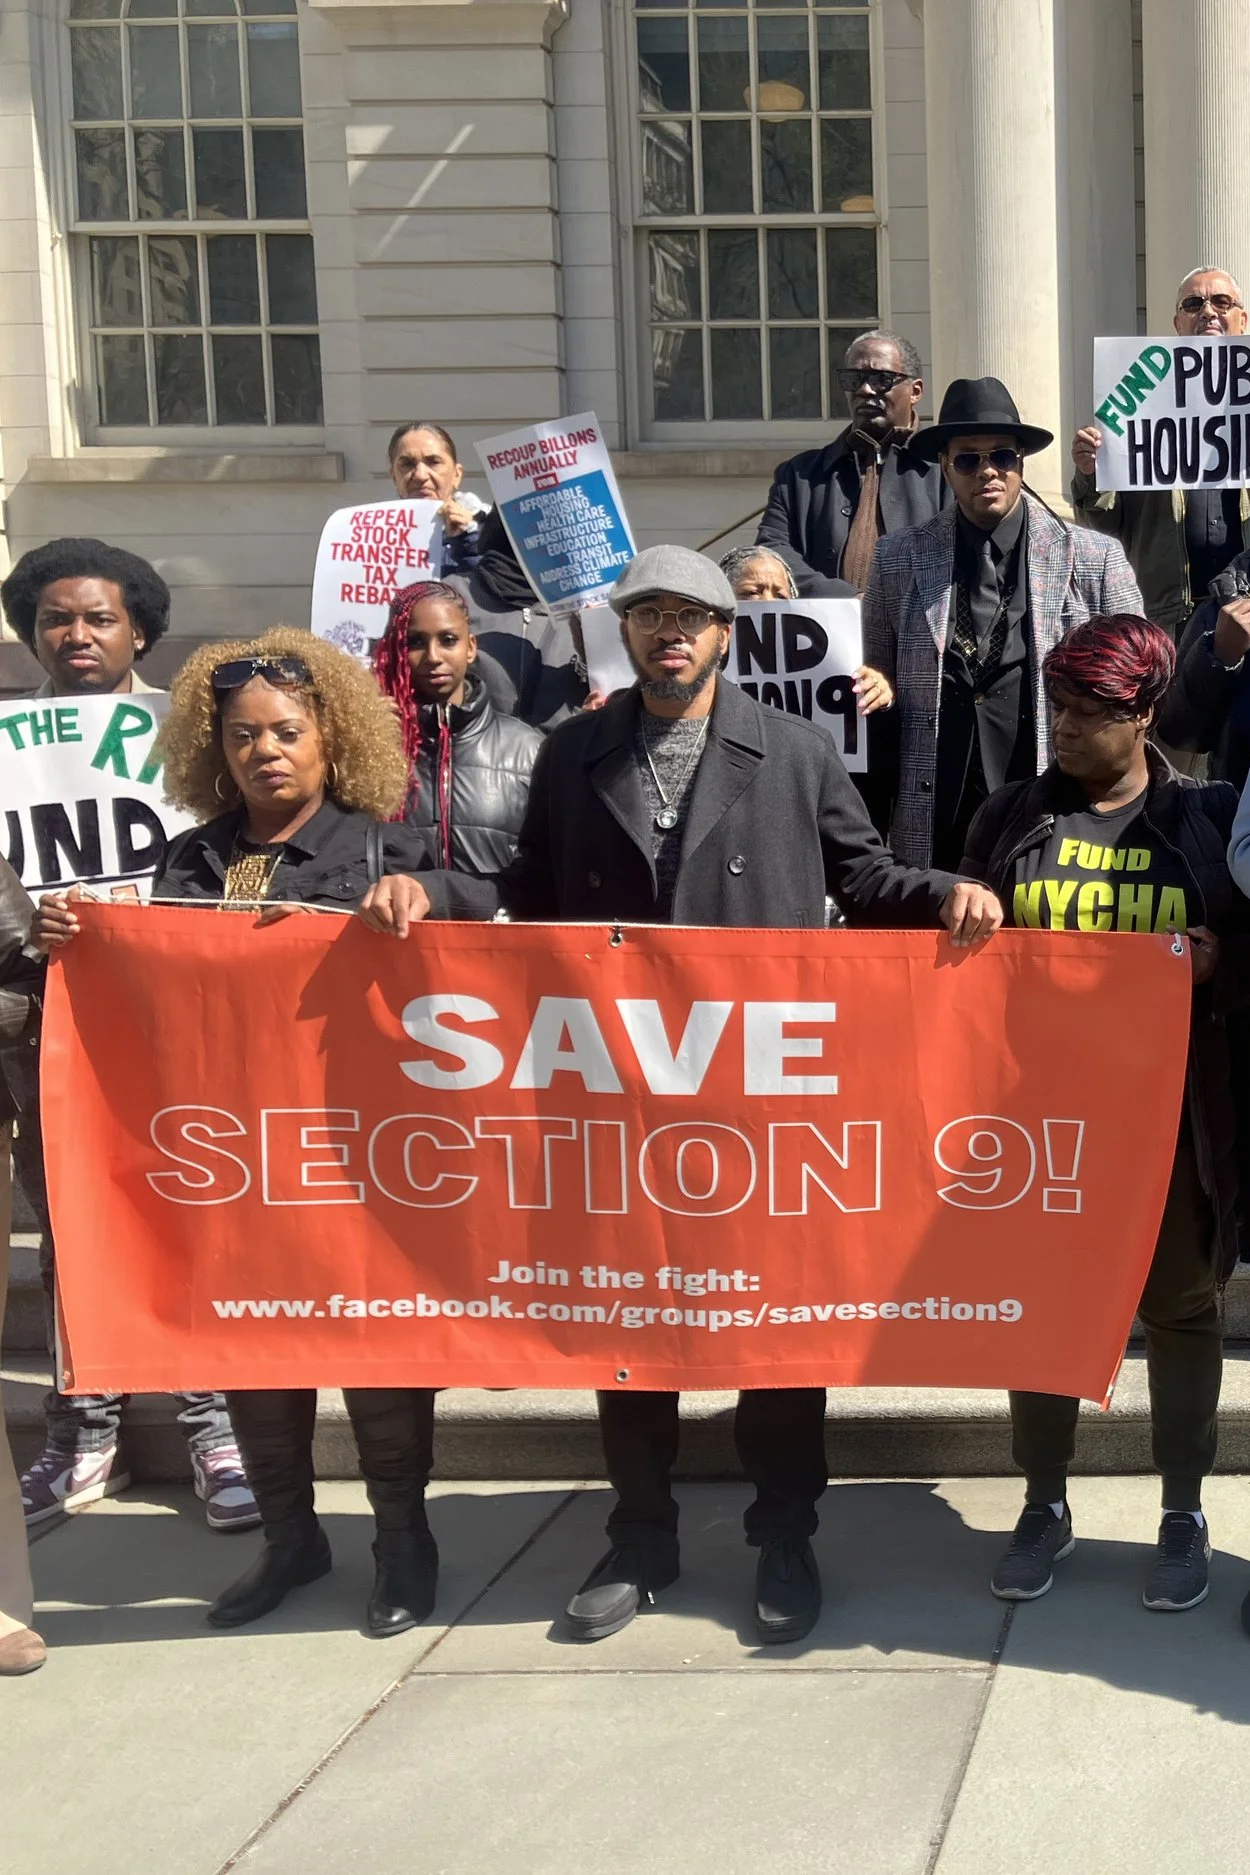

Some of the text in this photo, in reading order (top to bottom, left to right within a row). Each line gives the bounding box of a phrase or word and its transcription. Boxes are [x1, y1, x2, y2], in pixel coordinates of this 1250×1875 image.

[1094, 345, 1172, 437] FUND
[487, 443, 537, 470] RECOUP
[513, 450, 578, 481] ANNUALLY
[519, 485, 584, 514] AFFORDABLE
[540, 497, 590, 521] HOUSING
[350, 509, 418, 528] REPEAL
[523, 516, 614, 550] INFRASTRUCTURE
[536, 505, 607, 532] HEALTH CARE
[350, 526, 410, 547] STOCK
[546, 531, 607, 557] EDUCATION
[330, 543, 430, 569] TRANSFER
[539, 551, 630, 585] ADDRESS CLIMATE
[566, 543, 613, 565] TRANSIT
[362, 565, 398, 586] TAX
[559, 571, 602, 592] CHANGE
[720, 613, 829, 676] ND
[0, 708, 82, 751] THE
[1057, 838, 1151, 872] FUND
[1013, 879, 1187, 935] NYCHA
[398, 993, 839, 1096] SAVE
[145, 1104, 1085, 1217] SECTION 9!
[487, 1260, 761, 1296] Join the fight:
[211, 1294, 1023, 1332] www.facebook.com/groups/savesection9
